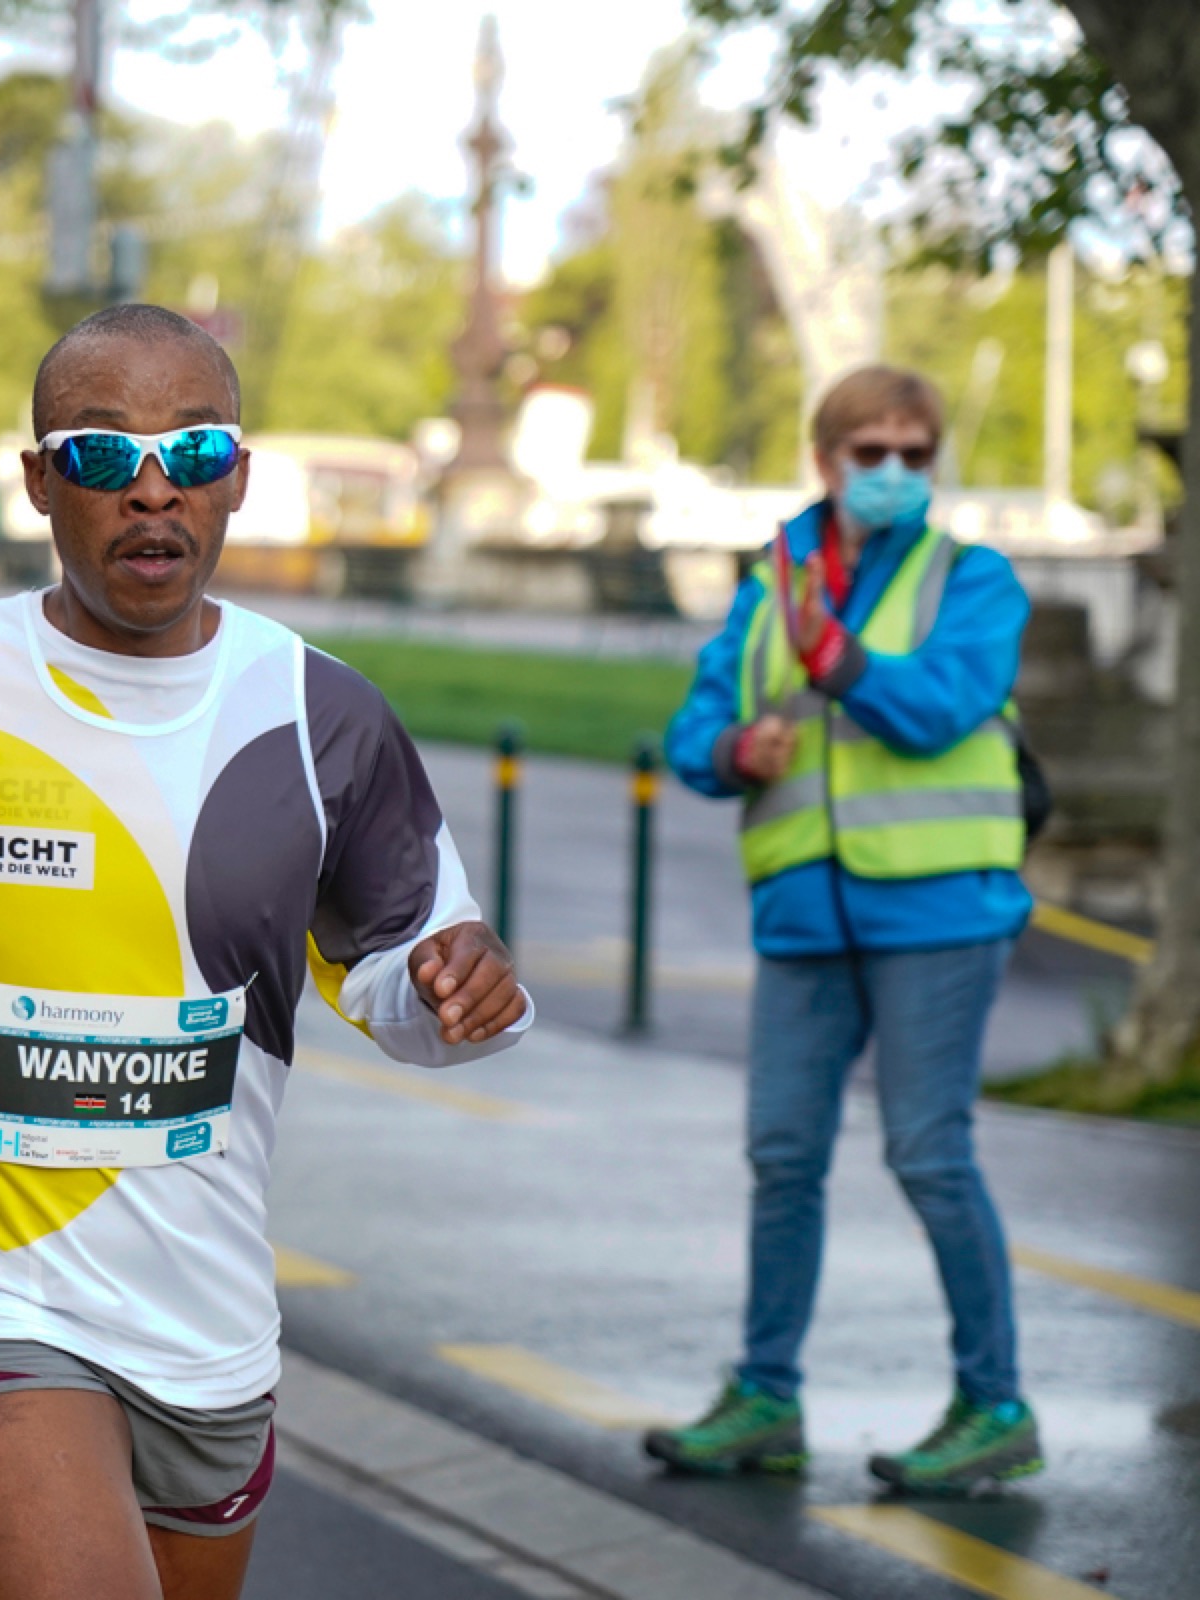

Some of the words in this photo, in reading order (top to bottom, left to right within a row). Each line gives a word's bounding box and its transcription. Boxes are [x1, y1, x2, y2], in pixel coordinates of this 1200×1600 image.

[8, 862, 32, 875] DIE
[36, 864, 78, 879] WELT
[40, 1000, 125, 1026] harmony
[17, 1044, 209, 1085] WANYOIKE
[119, 1092, 152, 1115] 14
